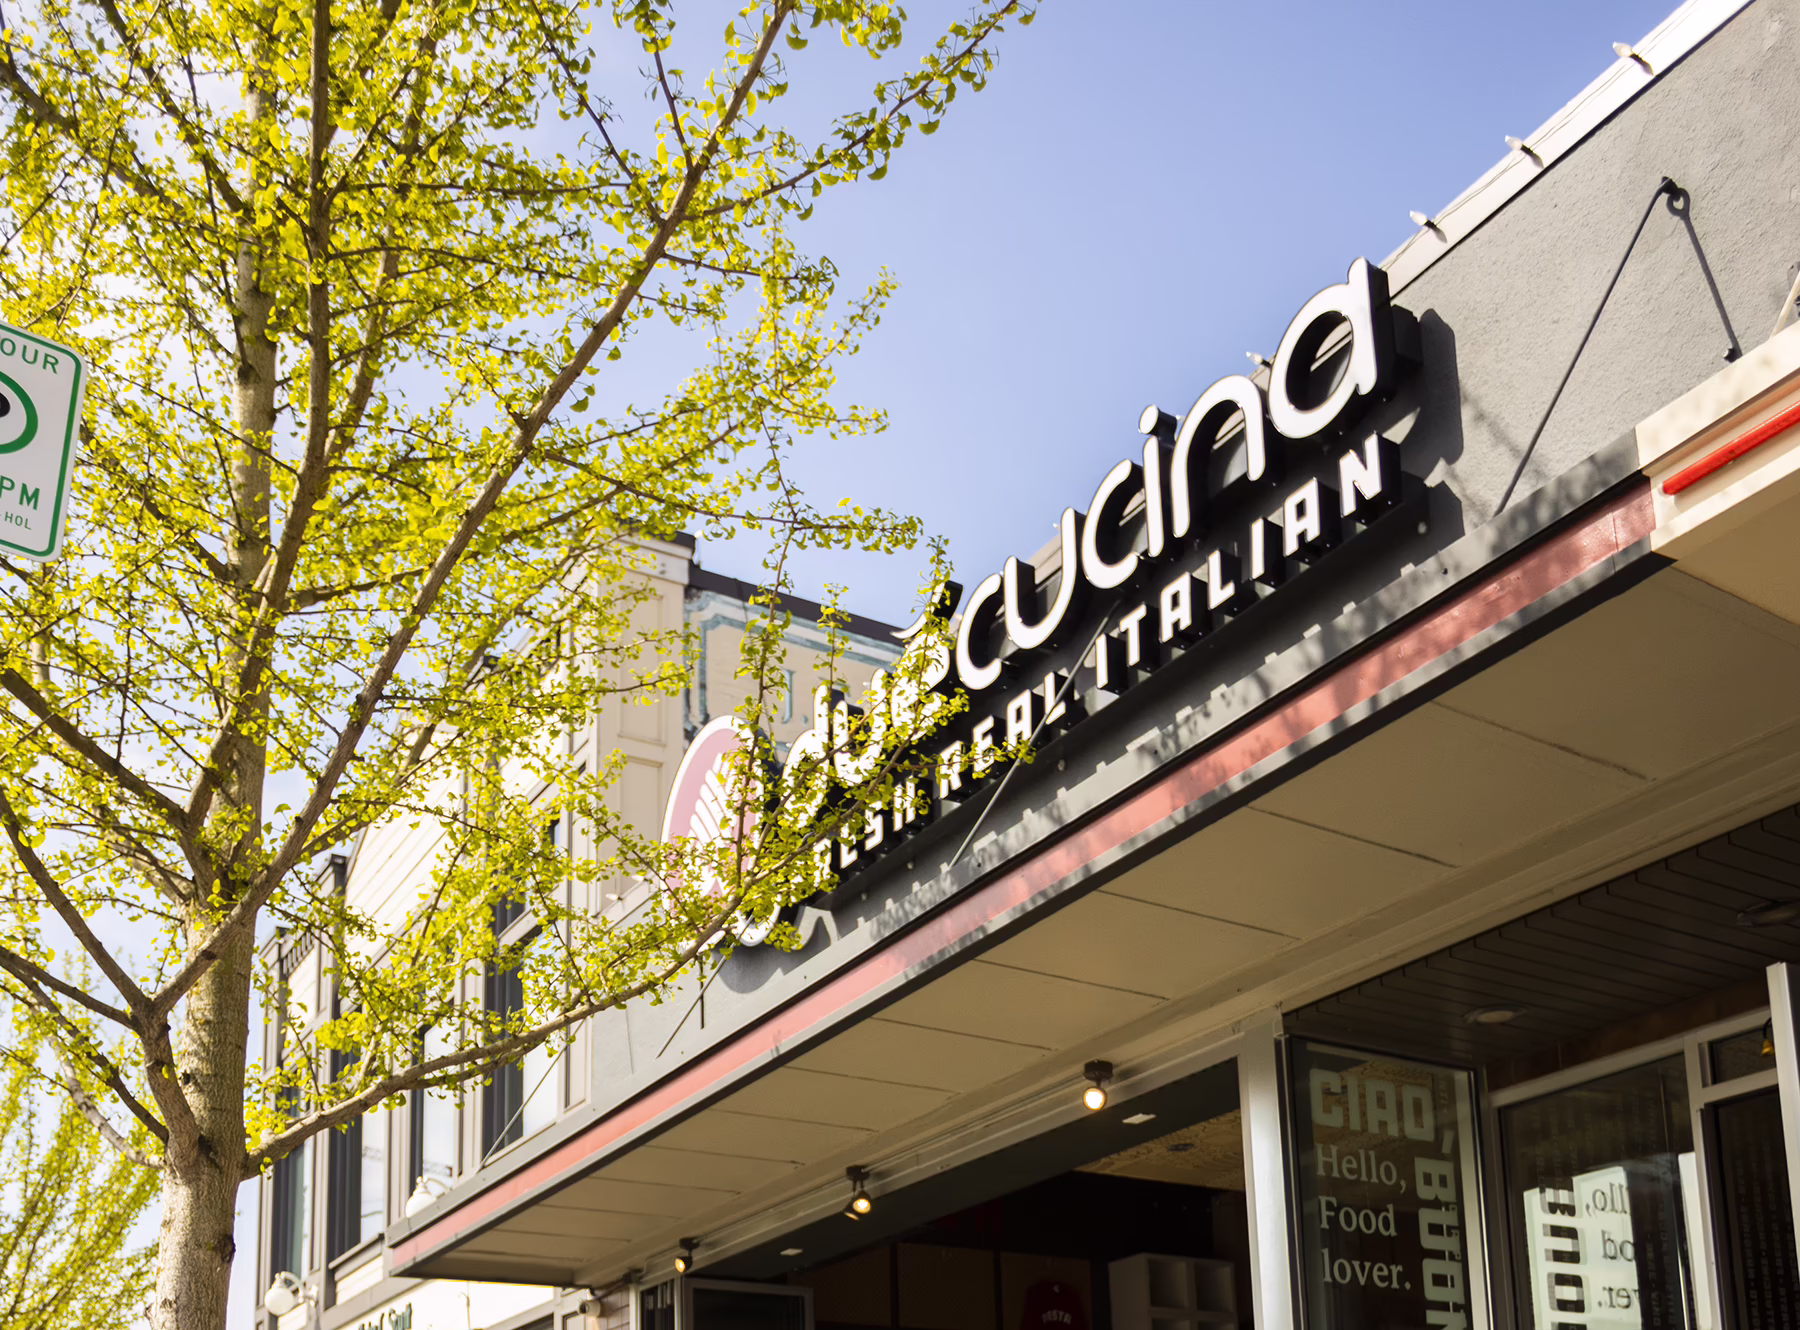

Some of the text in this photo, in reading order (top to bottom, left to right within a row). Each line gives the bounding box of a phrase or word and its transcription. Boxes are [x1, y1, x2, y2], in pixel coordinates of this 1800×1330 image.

[0, 337, 59, 375] OUR
[956, 256, 1380, 690] cucina
[0, 511, 32, 530] HOL
[791, 431, 1384, 903] RESH REAL ITALIAN
[1316, 1143, 1407, 1194] Hello,
[1318, 1195, 1398, 1238] Food
[1320, 1247, 1412, 1292] lover.
